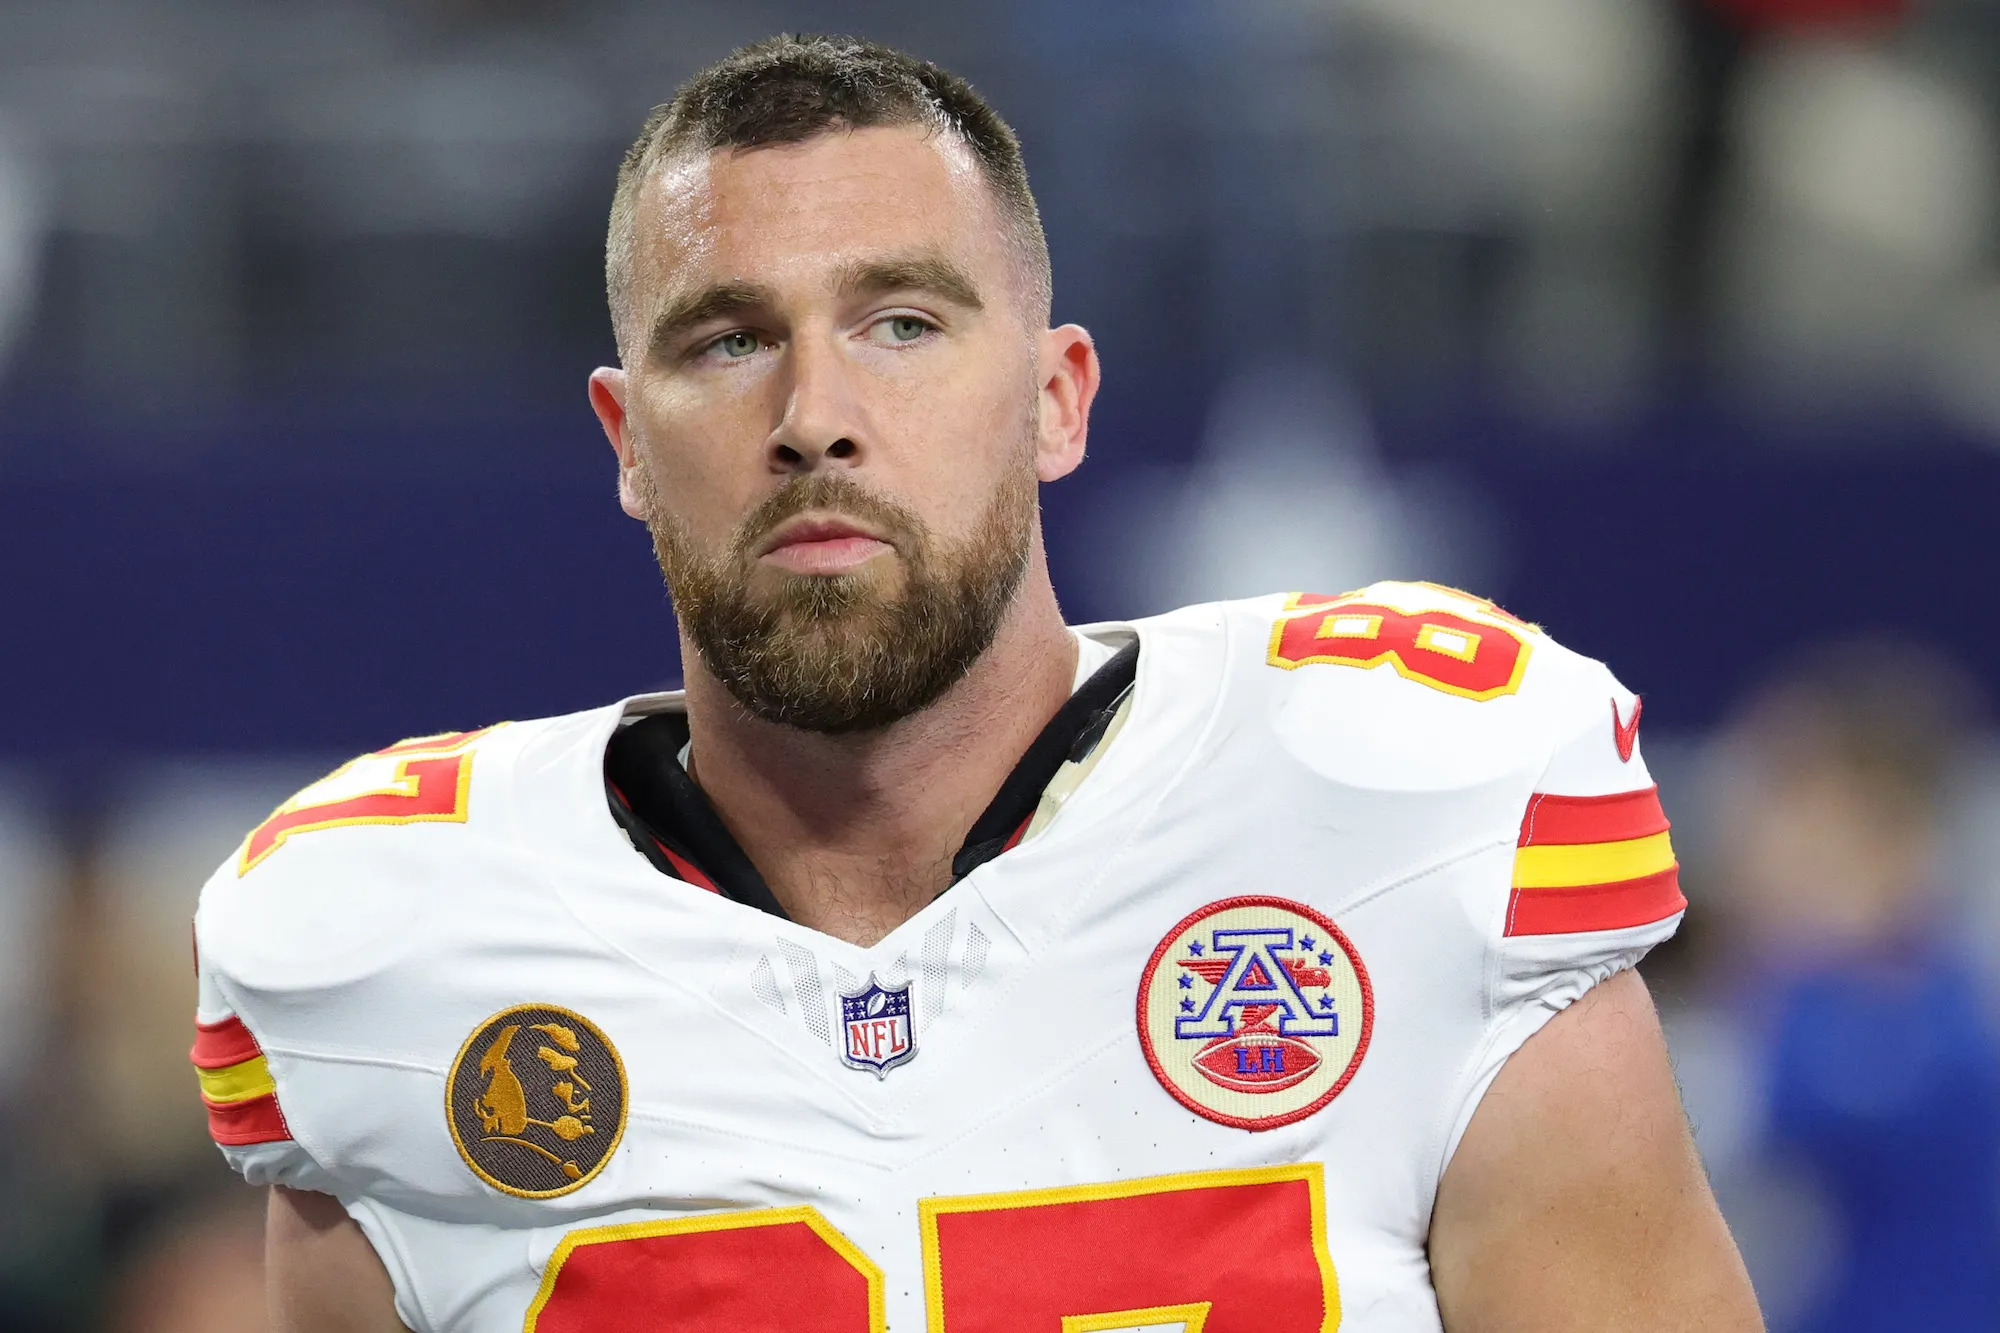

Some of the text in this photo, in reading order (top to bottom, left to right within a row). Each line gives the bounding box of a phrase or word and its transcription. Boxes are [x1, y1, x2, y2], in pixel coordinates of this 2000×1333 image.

[1175, 927, 1338, 1039] A
[849, 1019, 906, 1060] NFL
[1233, 1047, 1286, 1074] LH
